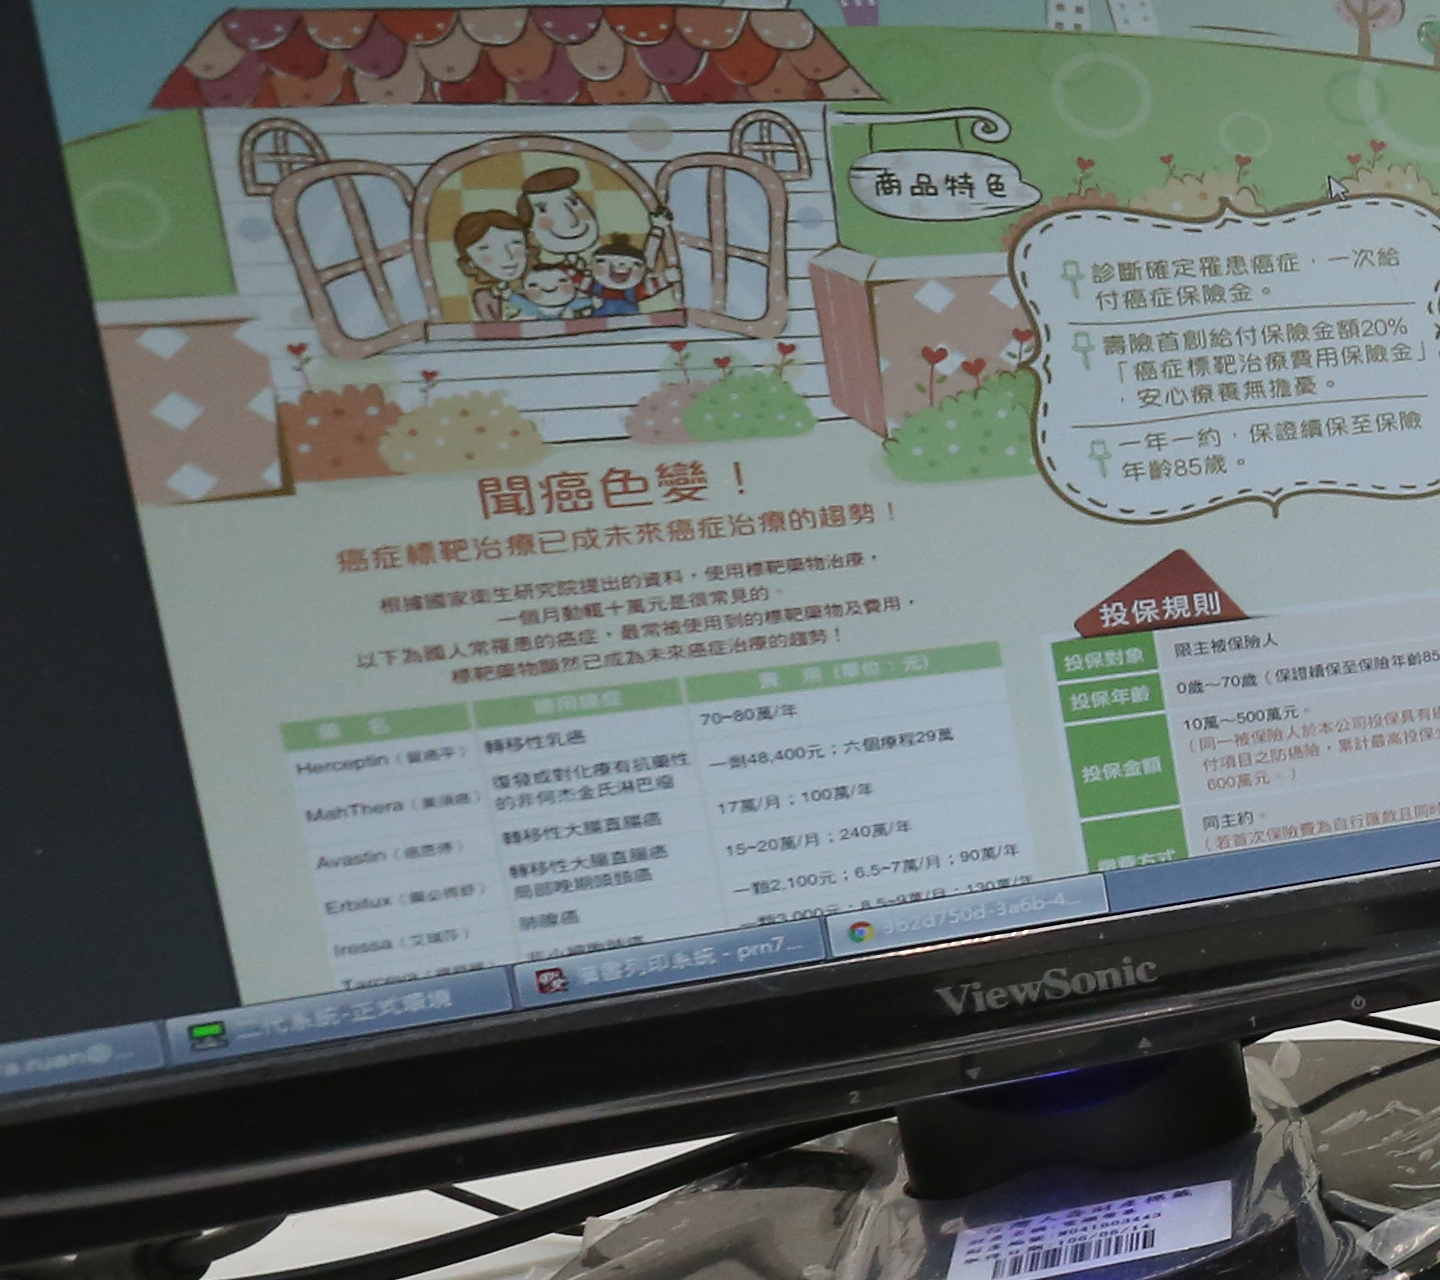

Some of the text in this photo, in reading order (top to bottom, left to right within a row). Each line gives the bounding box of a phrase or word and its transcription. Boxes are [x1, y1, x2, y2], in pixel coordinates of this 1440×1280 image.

[873, 168, 1008, 201] 商品特色
[1102, 317, 1408, 356] 壽險首創給付保險金額20%
[477, 460, 746, 520] 聞癌色變！
[335, 503, 896, 574] 癌症標靶治療已成未來癌症治療的趨勢！
[1099, 590, 1223, 628] 投保規則
[1063, 646, 1144, 671] 投保對象
[1174, 631, 1279, 658] 限主被保險人
[1070, 683, 1151, 711] 投保年齡
[1082, 757, 1163, 784] 投保金額
[936, 955, 1159, 1017] ViewSonic
